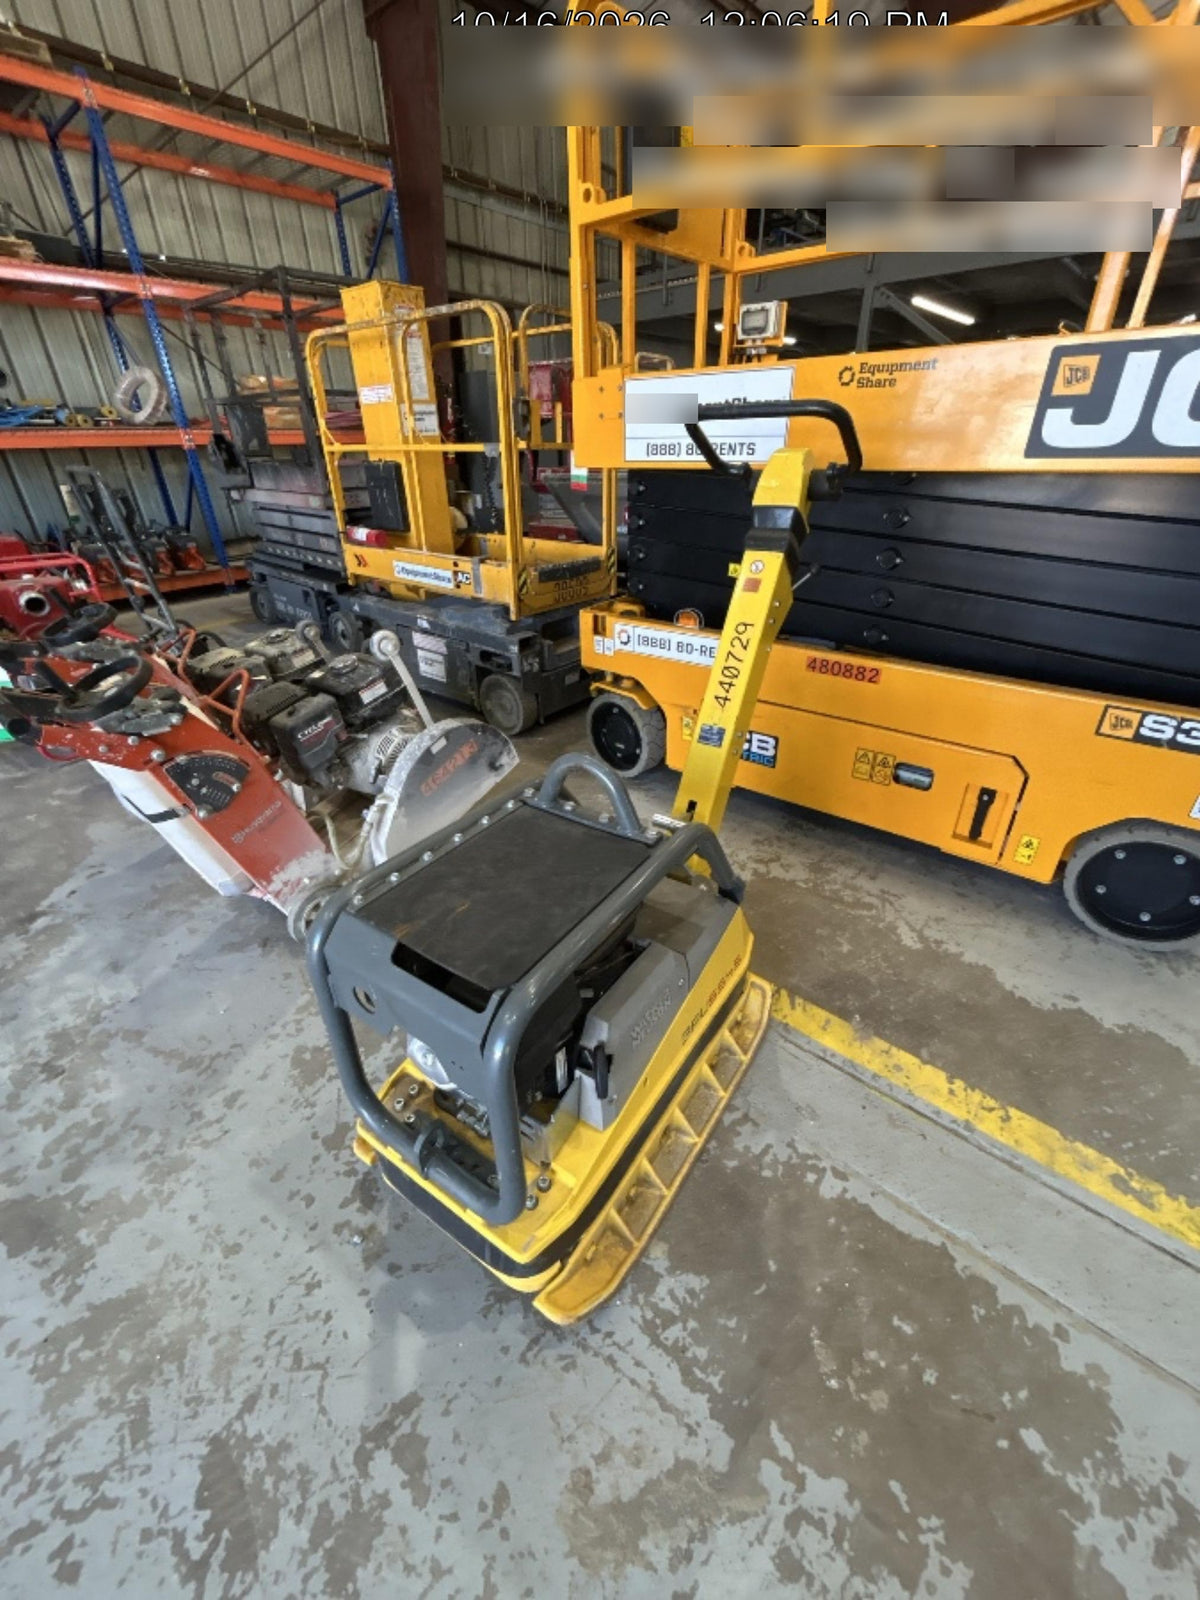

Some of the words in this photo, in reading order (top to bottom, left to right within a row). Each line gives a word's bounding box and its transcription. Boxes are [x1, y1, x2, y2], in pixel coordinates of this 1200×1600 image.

[859, 359, 938, 375] Equipment
[857, 377, 896, 388] Share
[714, 621, 754, 709] 440729
[807, 657, 880, 683] 480882
